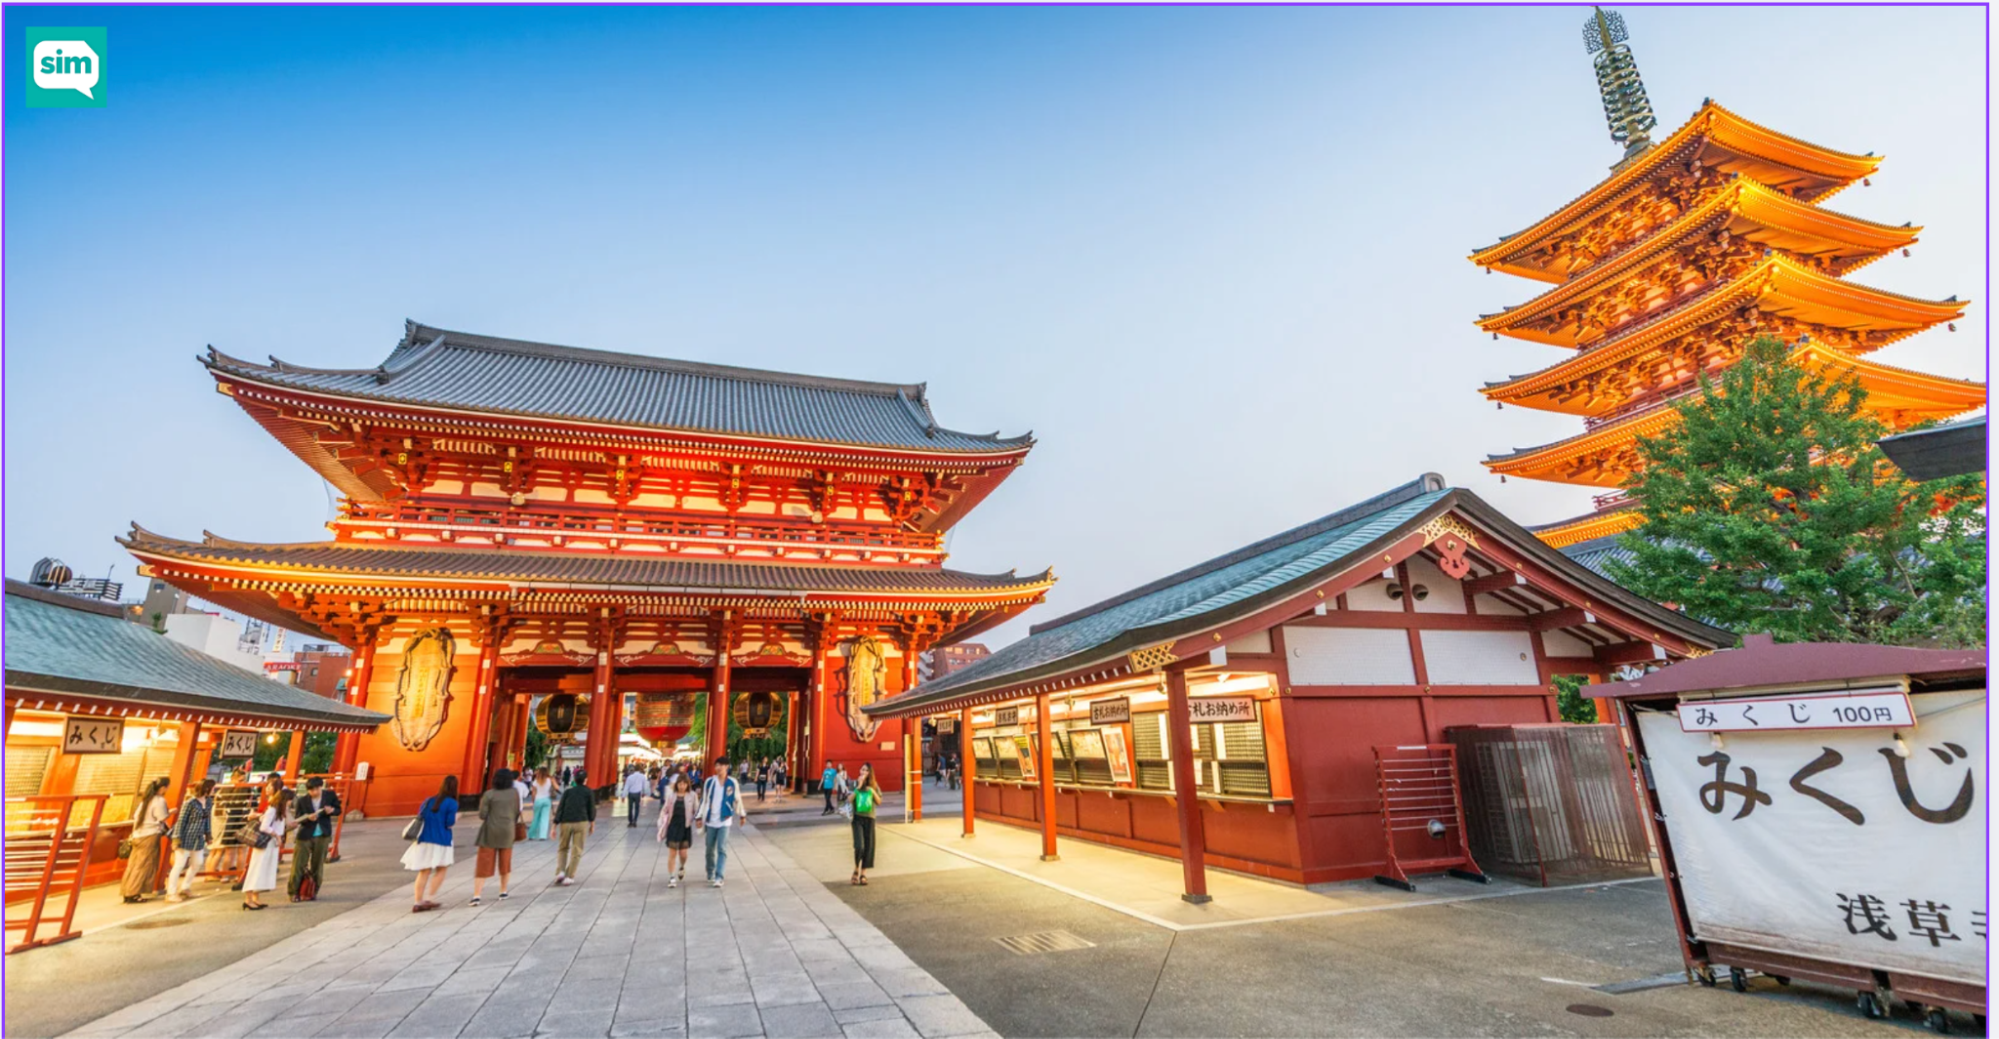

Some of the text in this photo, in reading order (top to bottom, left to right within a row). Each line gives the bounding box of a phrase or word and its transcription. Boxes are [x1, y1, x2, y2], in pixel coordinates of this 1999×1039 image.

[1695, 703, 1893, 727] みくじ 100円
[69, 725, 118, 745] みくじ
[1697, 742, 1975, 826] みくじ
